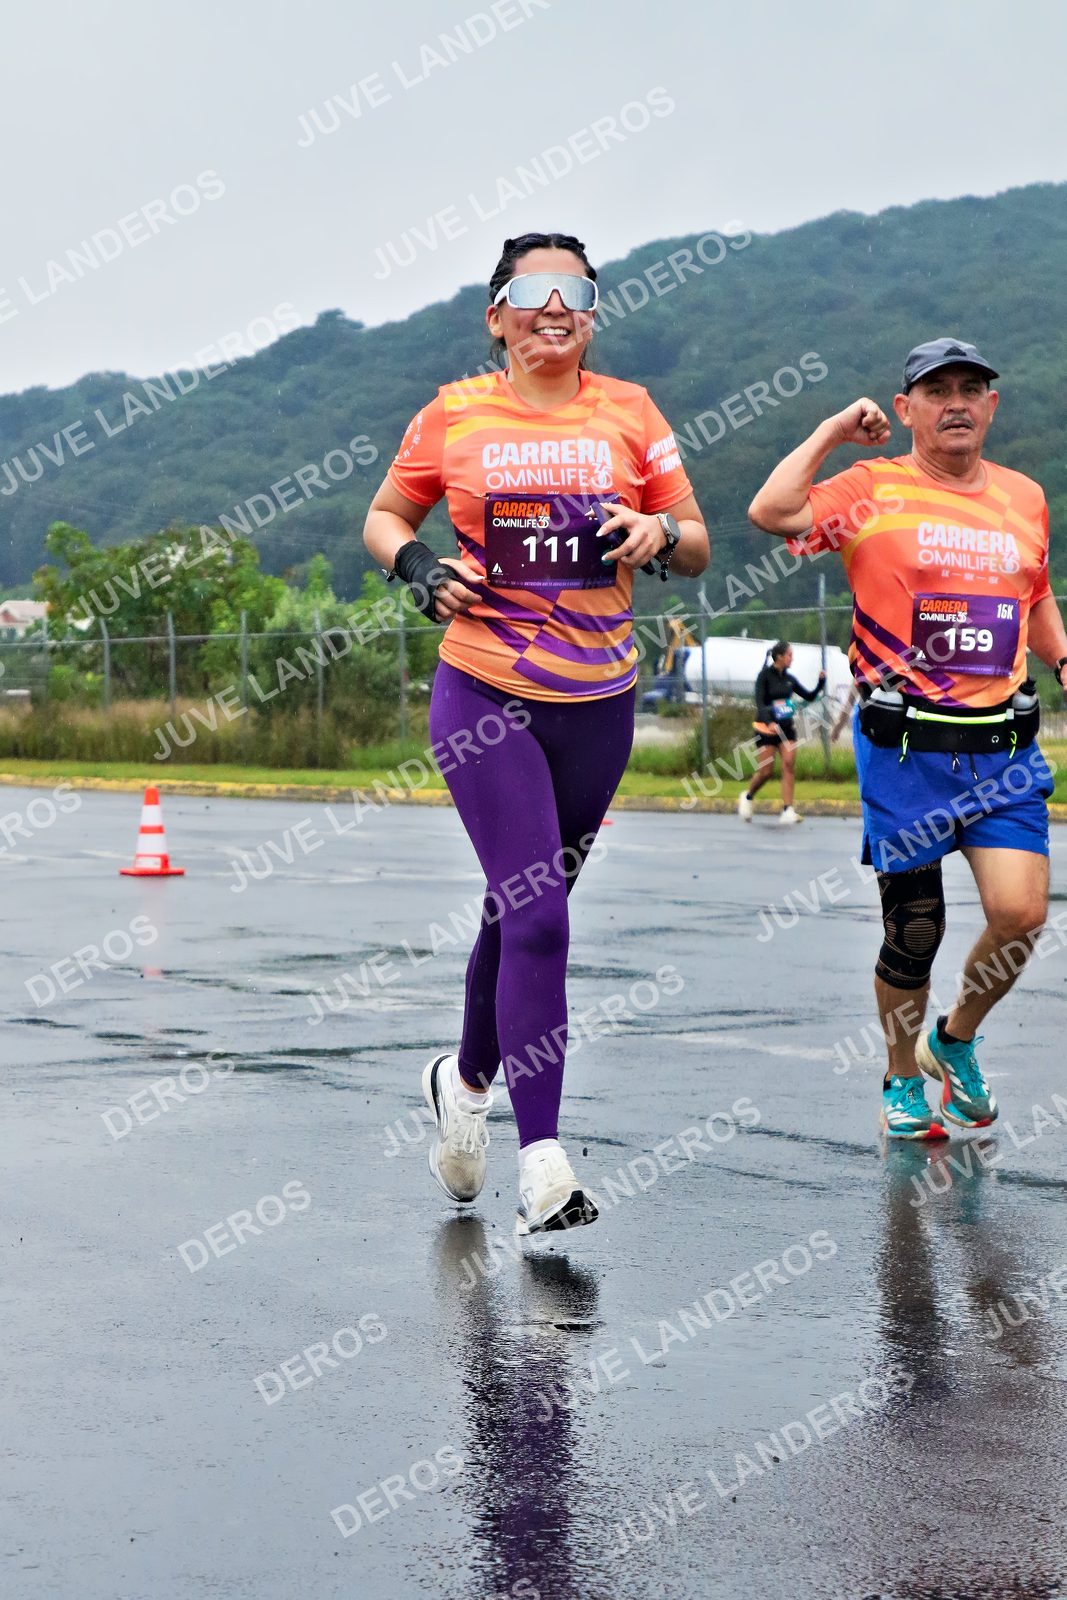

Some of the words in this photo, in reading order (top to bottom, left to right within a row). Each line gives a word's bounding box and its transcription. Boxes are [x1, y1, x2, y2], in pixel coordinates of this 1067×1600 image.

[482, 439, 613, 469] CARRERA
[486, 467, 590, 489] OMNILIFE
[492, 502, 551, 517] CARRERA
[492, 517, 537, 529] OMNILIFE
[522, 535, 579, 563] 111
[918, 521, 1019, 556] CARRERA
[918, 548, 999, 573] OMNILIFE
[919, 612, 956, 622] OMNILIFE
[920, 599, 968, 613] CARRERA
[996, 603, 1014, 620] 15K
[944, 627, 993, 652] 159
